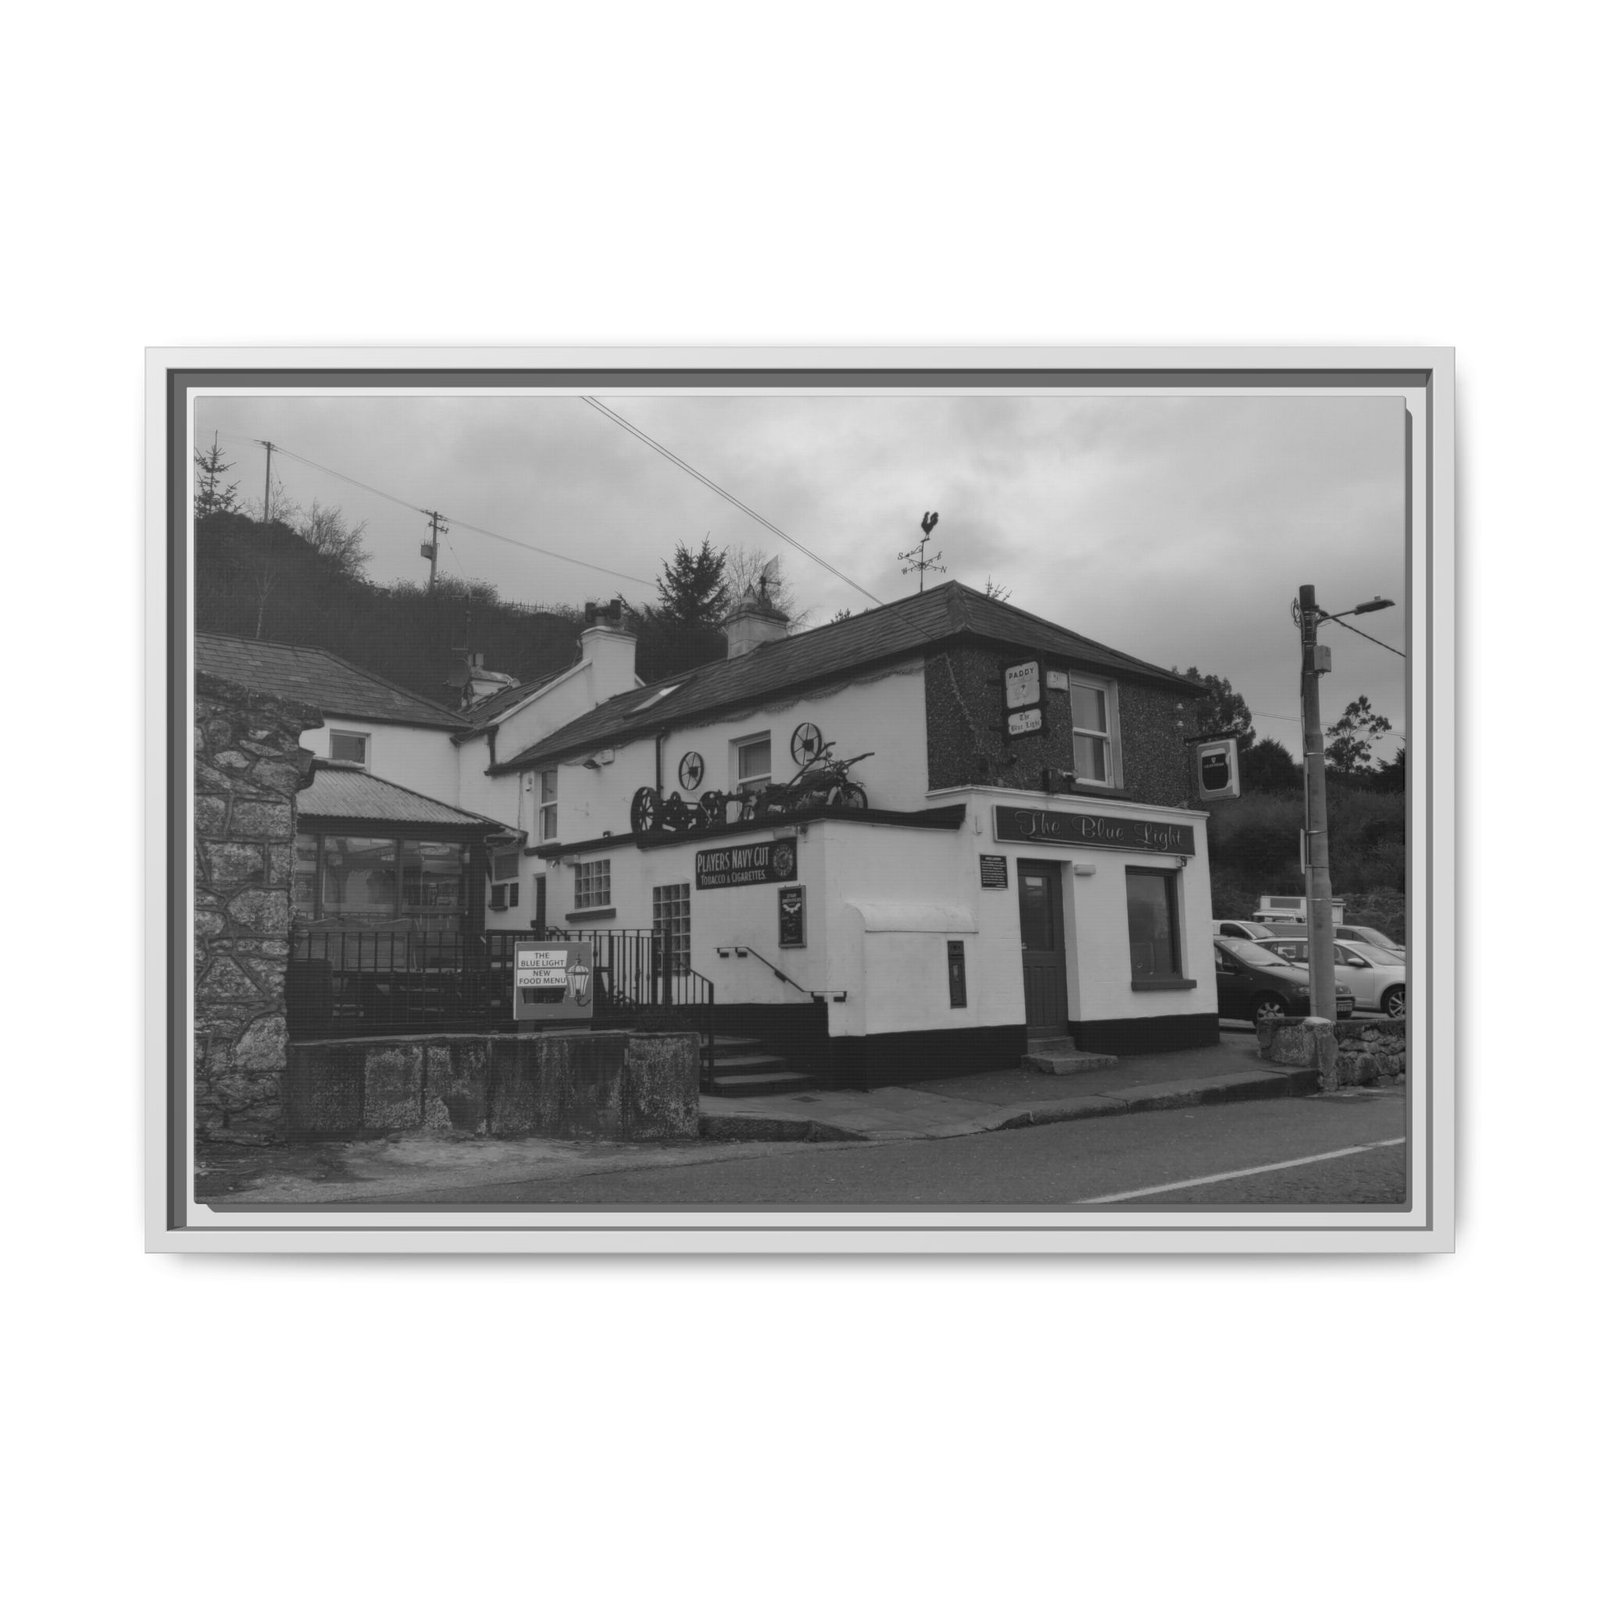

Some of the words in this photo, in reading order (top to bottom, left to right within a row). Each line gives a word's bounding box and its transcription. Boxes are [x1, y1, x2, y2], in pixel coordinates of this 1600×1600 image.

[1008, 667, 1035, 679] PADDY
[1014, 810, 1061, 836] The
[1071, 814, 1125, 841] Blue
[1133, 822, 1182, 851] Light
[697, 852, 730, 873] PLAYERS
[732, 848, 753, 868] NAVY
[754, 847, 769, 866] CUT
[701, 873, 726, 886] TOBACCO
[518, 977, 542, 985] FOOD
